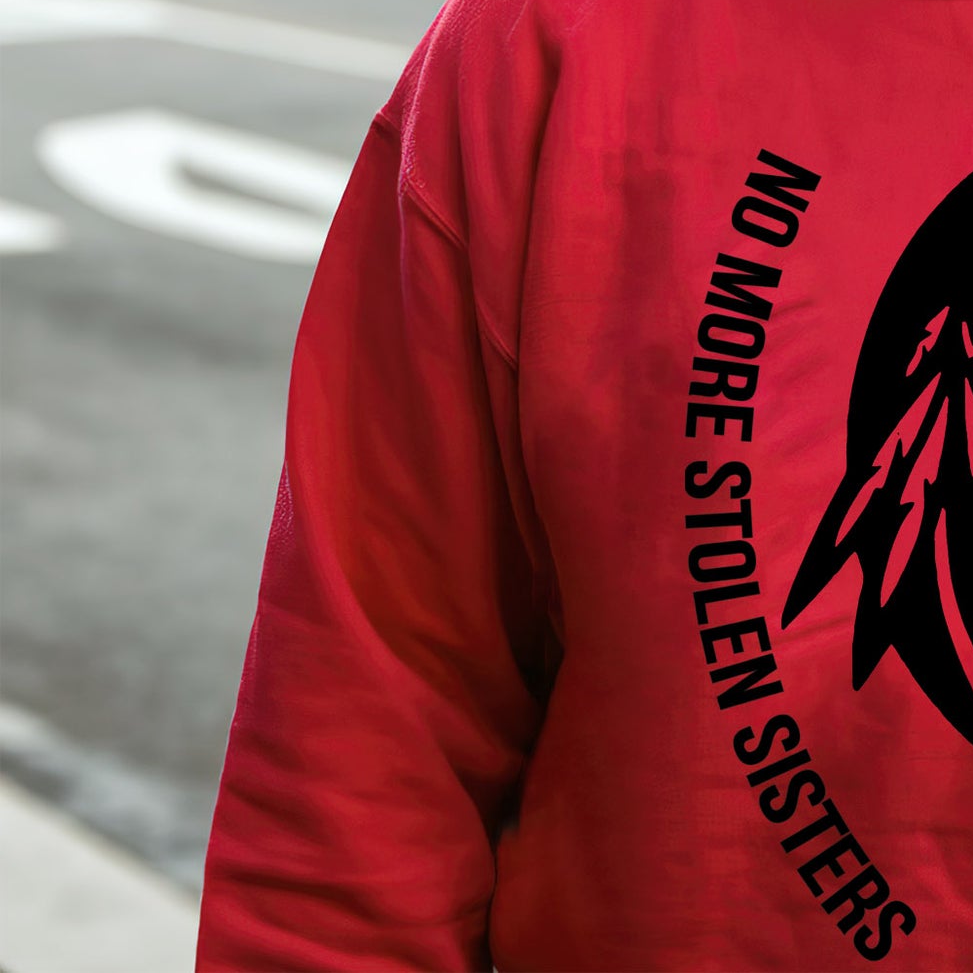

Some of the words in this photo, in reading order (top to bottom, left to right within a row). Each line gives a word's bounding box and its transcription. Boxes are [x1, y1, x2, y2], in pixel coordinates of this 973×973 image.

[731, 148, 821, 248] NO
[685, 252, 783, 442] MORE
[684, 460, 784, 710] STOLEN
[733, 714, 917, 962] SISTERS
